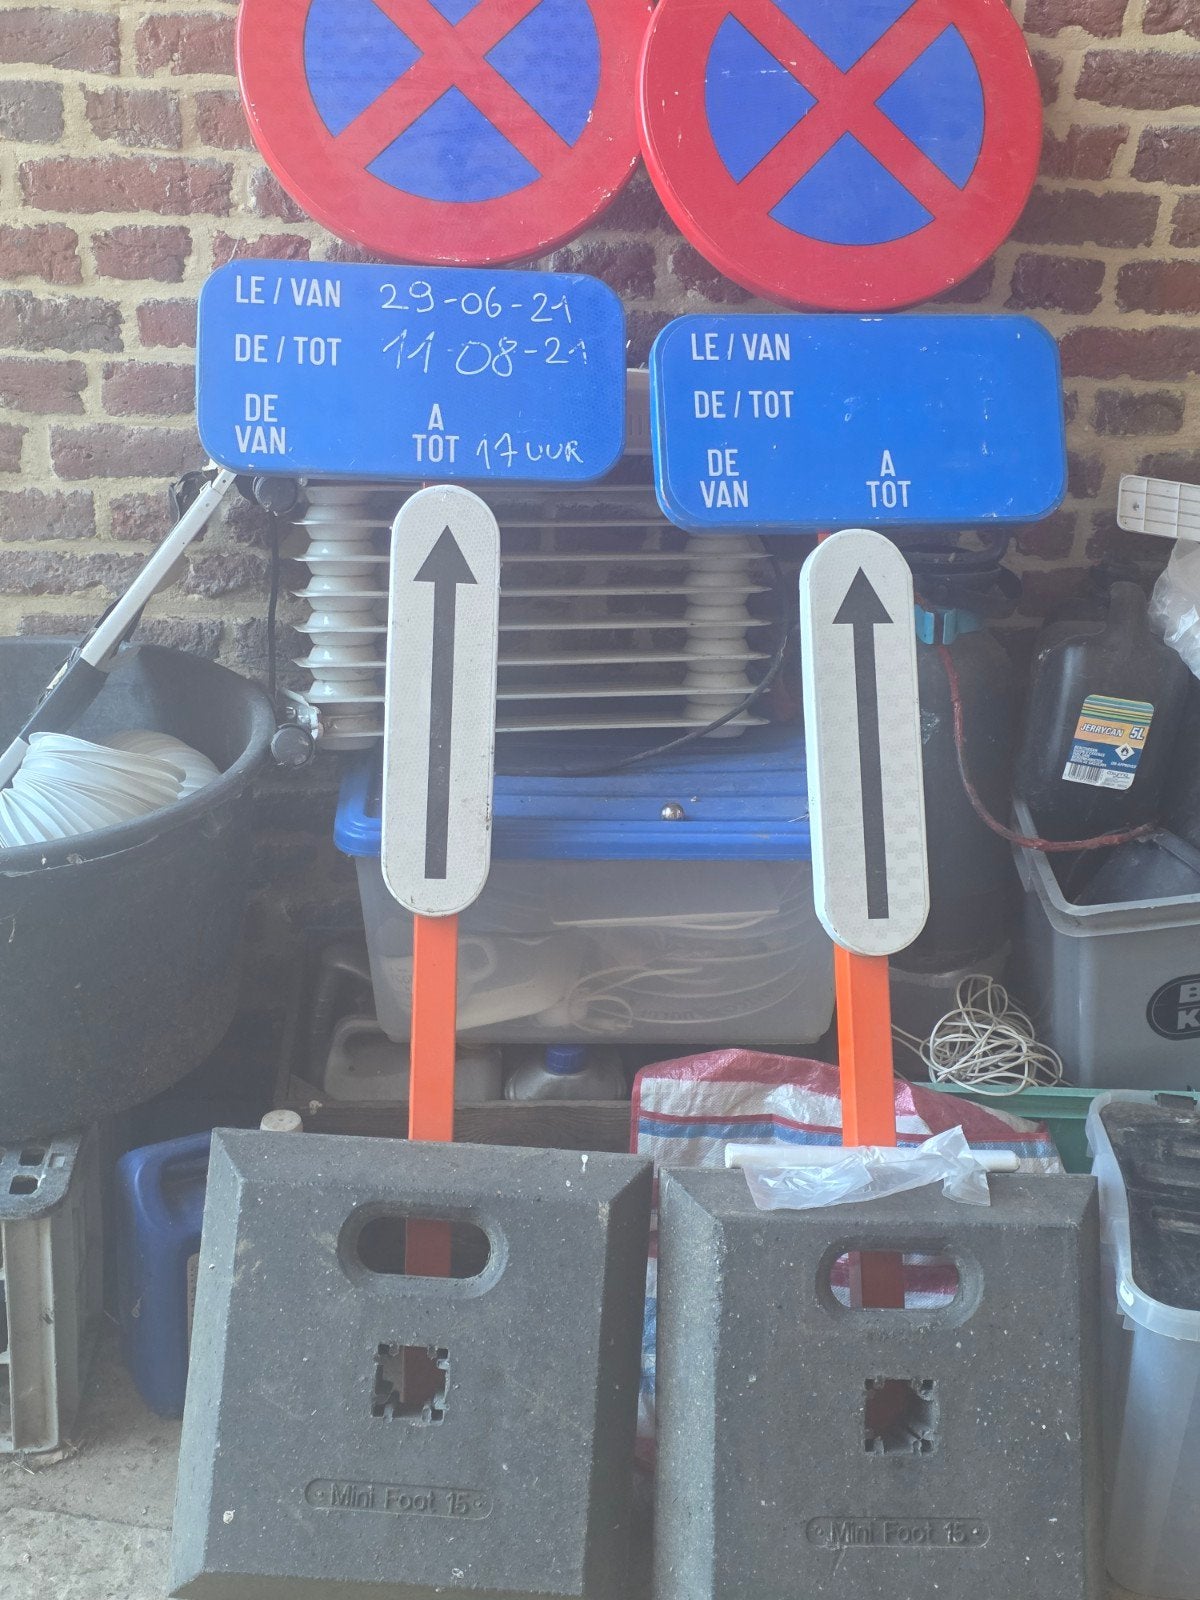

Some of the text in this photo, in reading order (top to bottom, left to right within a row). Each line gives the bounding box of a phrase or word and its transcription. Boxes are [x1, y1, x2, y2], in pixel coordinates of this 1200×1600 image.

[236, 276, 264, 303] LE
[291, 278, 340, 307] VAN
[236, 334, 267, 362] DE
[294, 337, 341, 365] TOT
[692, 333, 719, 360] LE
[743, 334, 790, 360] VAN
[246, 394, 277, 422] DE
[428, 404, 443, 430] A
[695, 391, 725, 418] DE
[749, 391, 793, 418] TOT
[235, 426, 285, 454] VAN
[413, 434, 459, 462] TOT
[477, 433, 518, 469] 17
[708, 449, 739, 476] DE
[880, 450, 895, 476] A
[700, 481, 748, 507] VAN
[866, 481, 910, 507] TOT
[1080, 723, 1145, 740] JERRYCAN 5L
[330, 1483, 468, 1514] Mini Foot 15
[829, 1520, 965, 1543] Mini Foot 15
